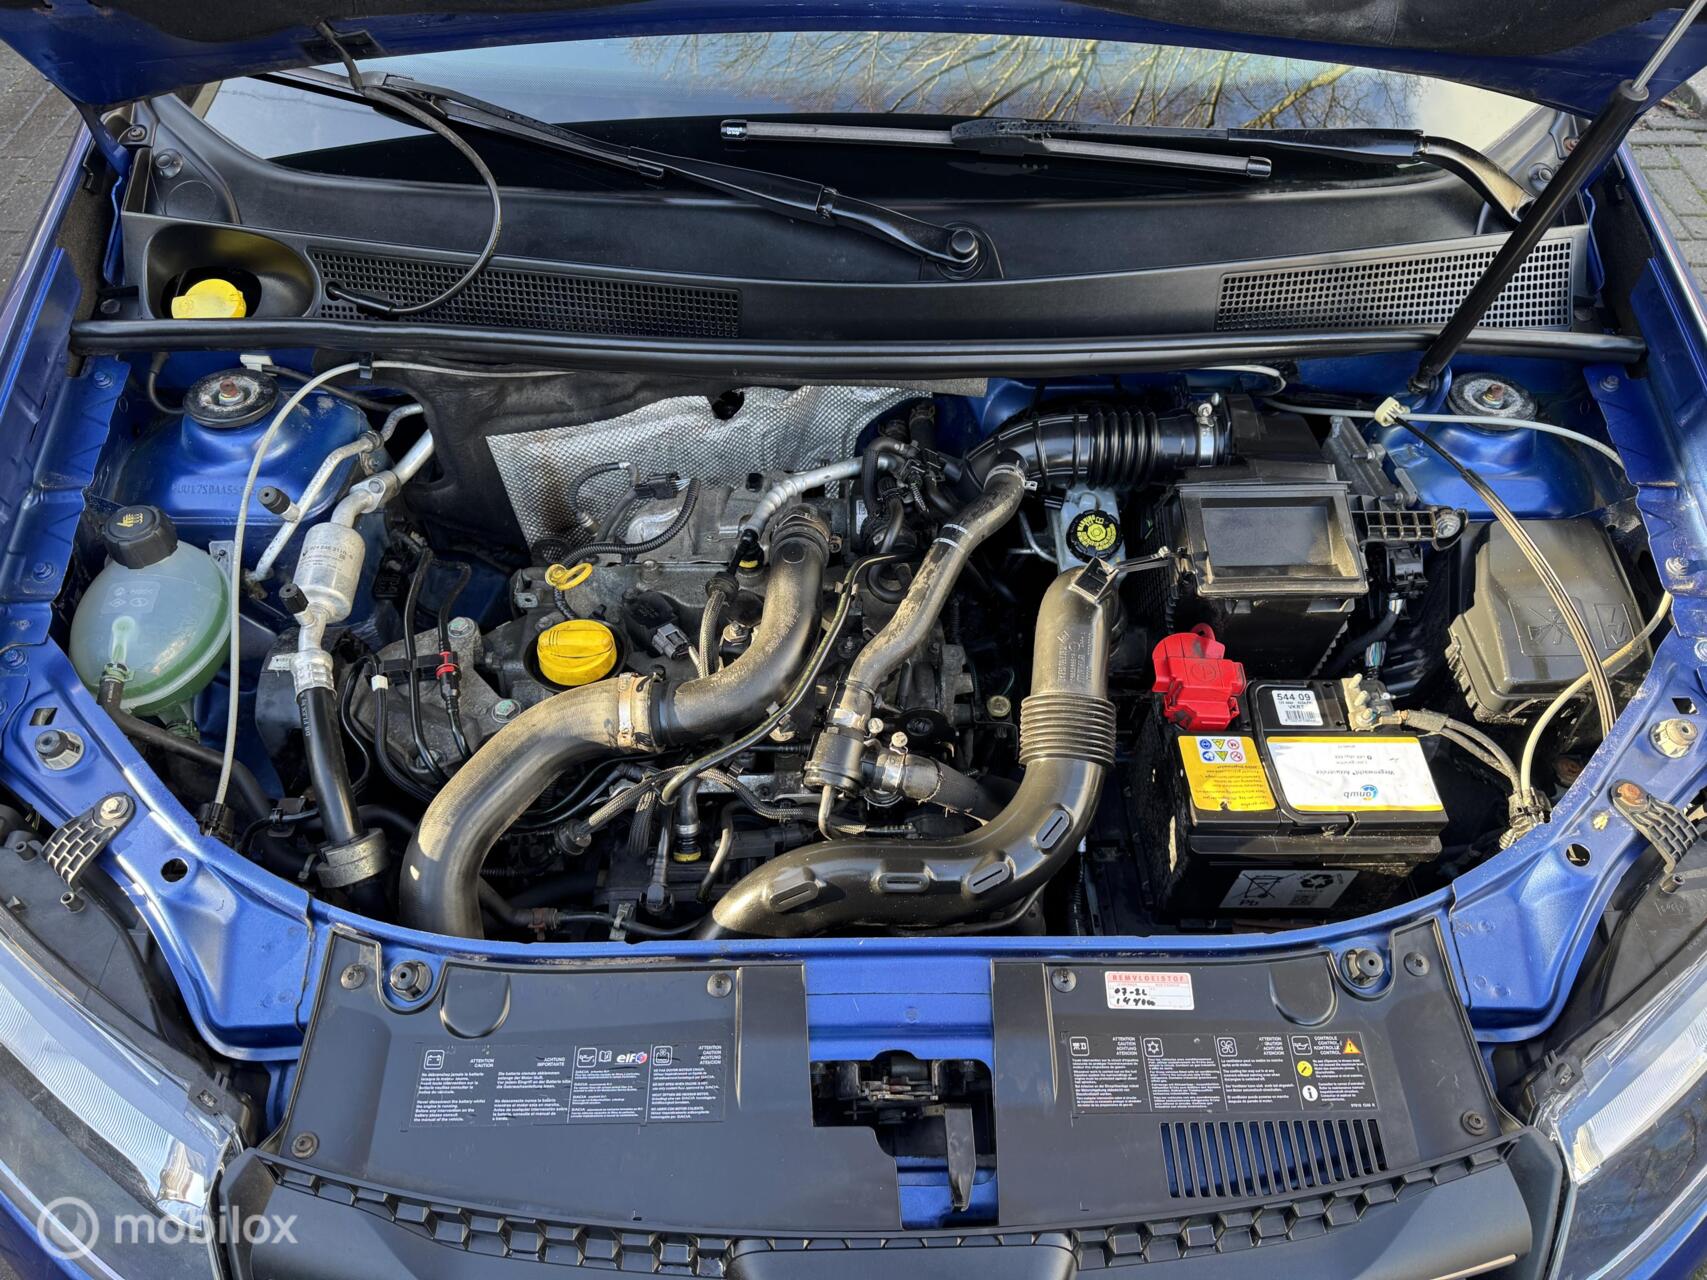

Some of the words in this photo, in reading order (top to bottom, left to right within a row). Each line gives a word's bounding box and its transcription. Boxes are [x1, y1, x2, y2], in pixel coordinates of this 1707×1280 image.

[1277, 693, 1295, 701] 544
[1298, 693, 1311, 701] 09
[616, 1054, 636, 1063] elf
